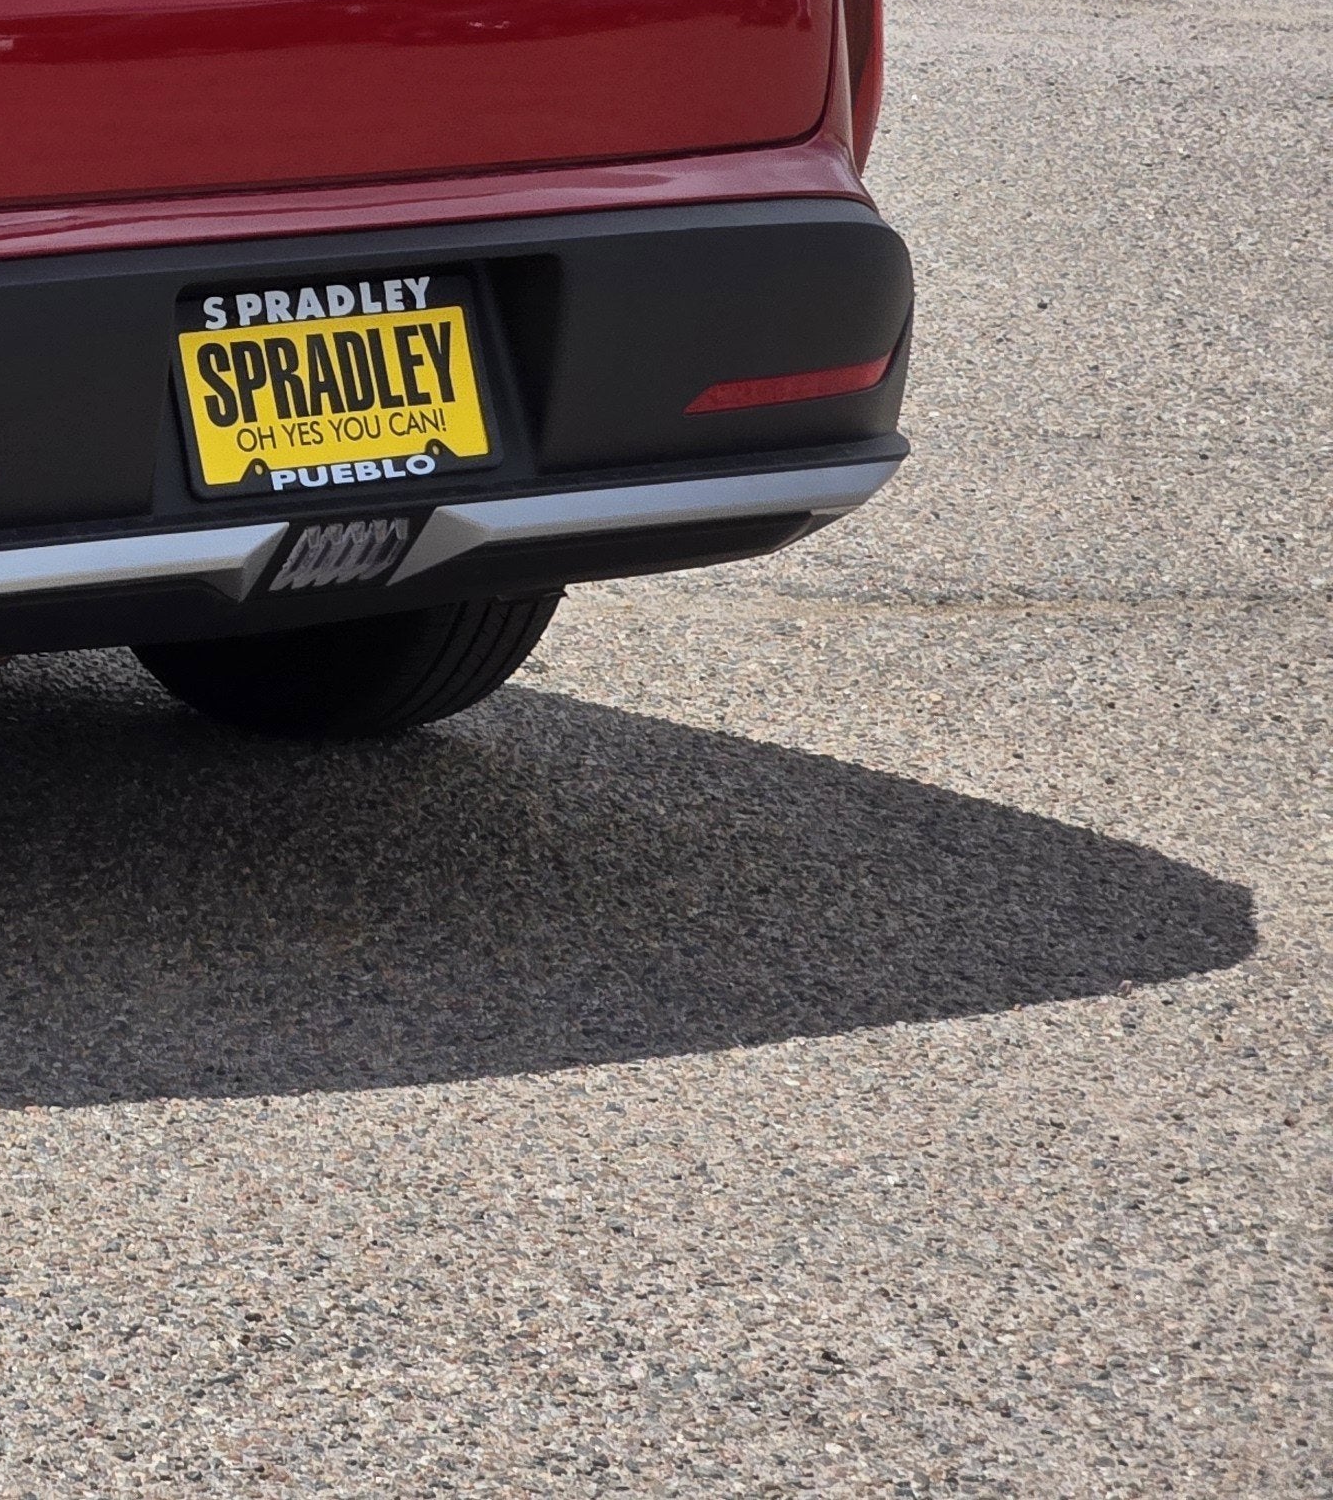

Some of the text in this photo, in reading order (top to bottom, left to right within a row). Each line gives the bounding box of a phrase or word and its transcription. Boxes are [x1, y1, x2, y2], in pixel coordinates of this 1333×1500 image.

[202, 276, 431, 331] SPRADLEY
[196, 320, 457, 428] SPRADLEY
[236, 408, 448, 453] OH YES YOU CAN!
[270, 453, 437, 491] PUEBLO
